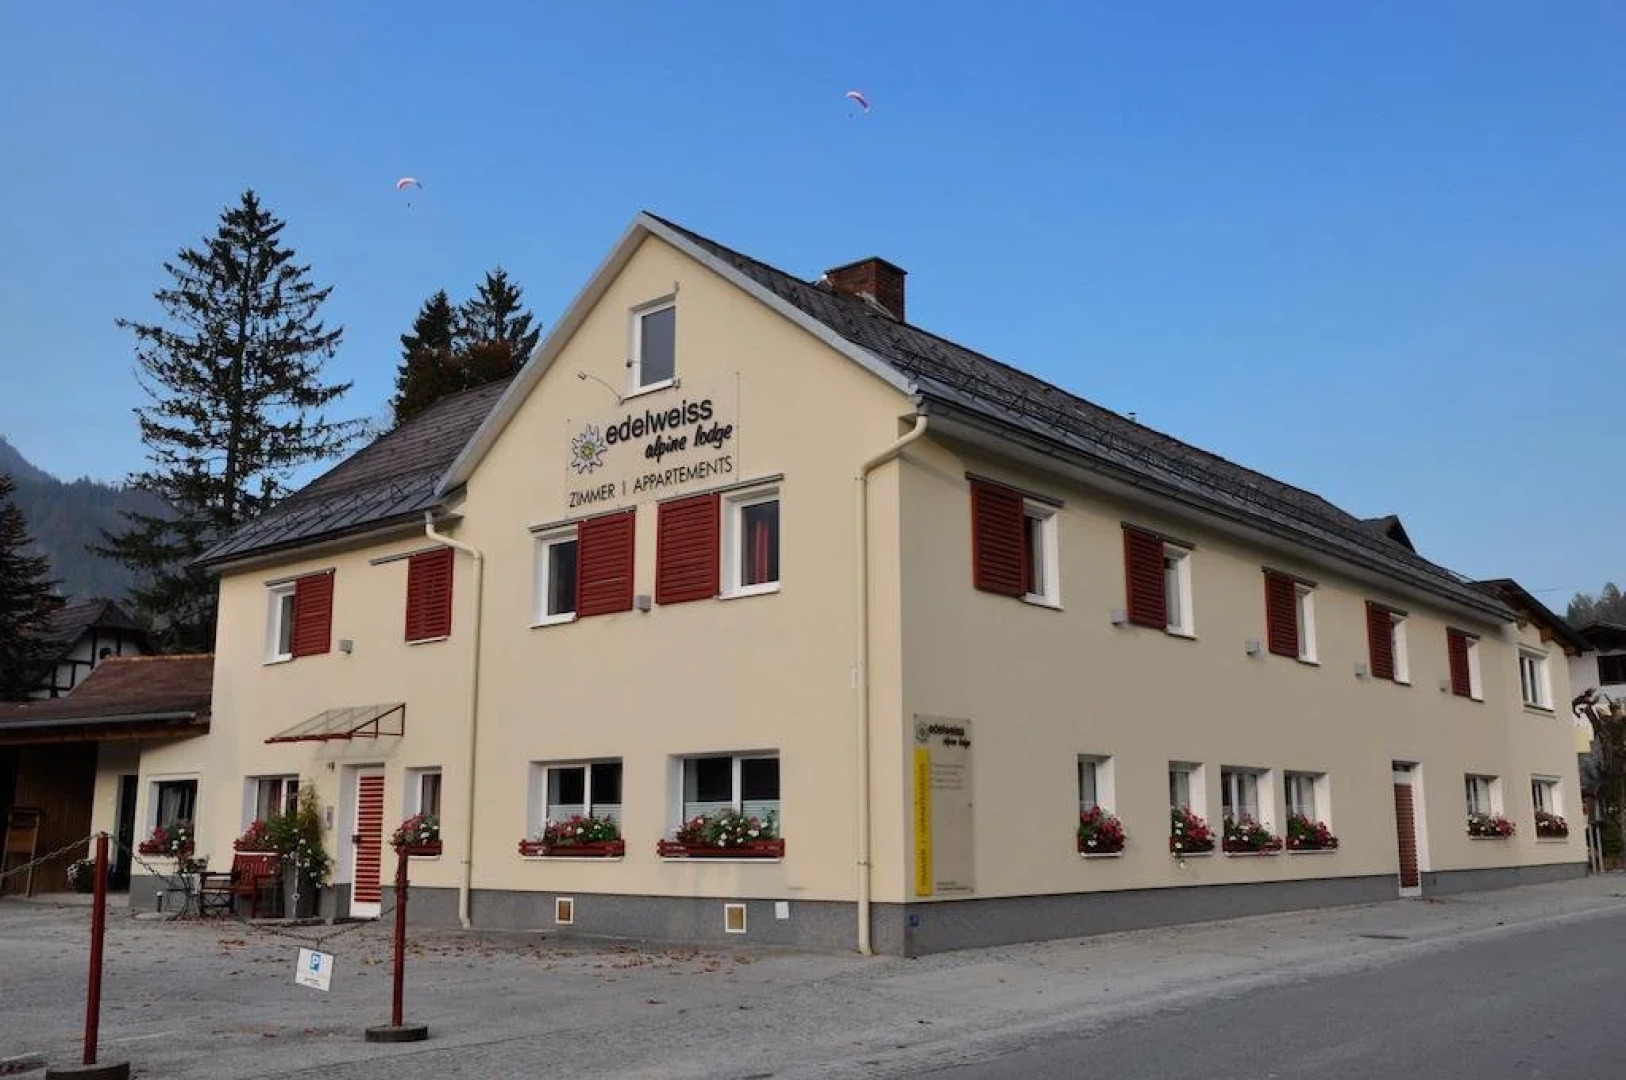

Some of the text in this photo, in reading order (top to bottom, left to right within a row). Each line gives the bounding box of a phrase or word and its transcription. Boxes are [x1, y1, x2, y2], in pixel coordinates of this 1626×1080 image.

[605, 399, 713, 445] edelweiss
[645, 421, 733, 463] alpine lodge
[569, 483, 615, 508] ZIMMER
[633, 455, 733, 493] APPARTEMENTS
